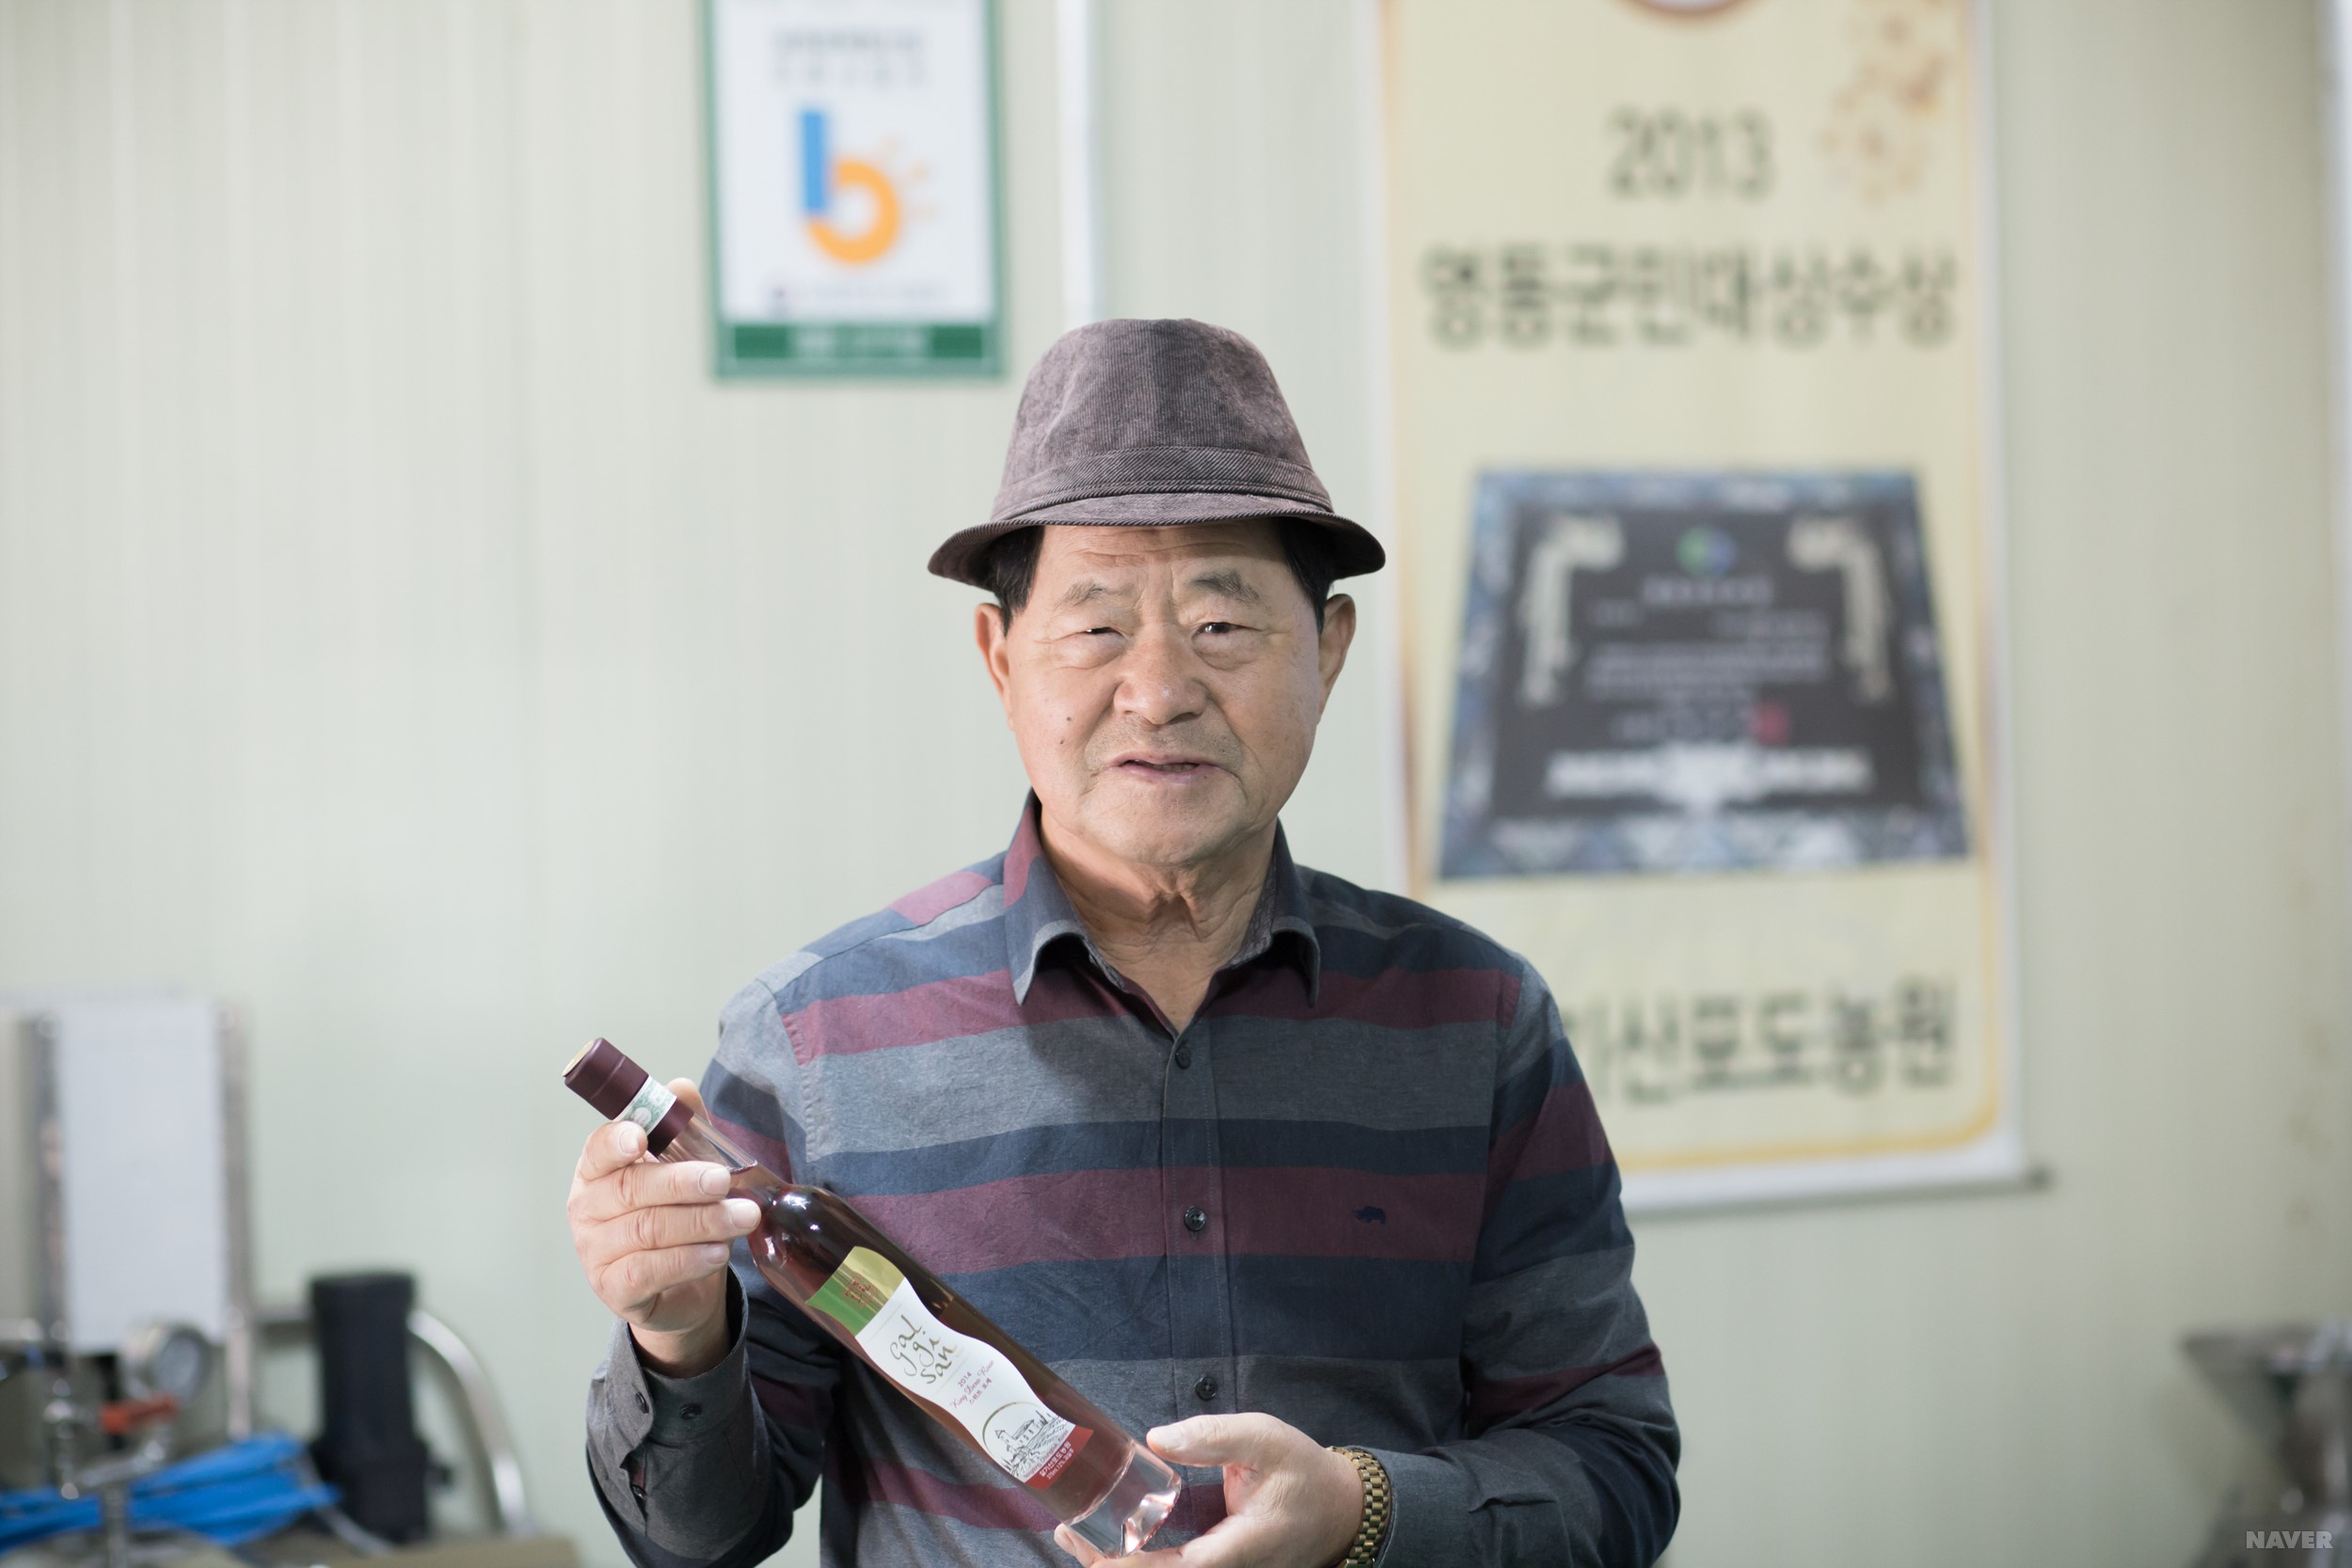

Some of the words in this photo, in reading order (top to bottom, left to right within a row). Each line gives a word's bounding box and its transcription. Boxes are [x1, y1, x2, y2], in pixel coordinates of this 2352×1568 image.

[1607, 105, 1774, 201] 2013
[921, 1345, 957, 1384] san
[958, 1371, 972, 1387] 2014
[950, 1395, 968, 1409] King
